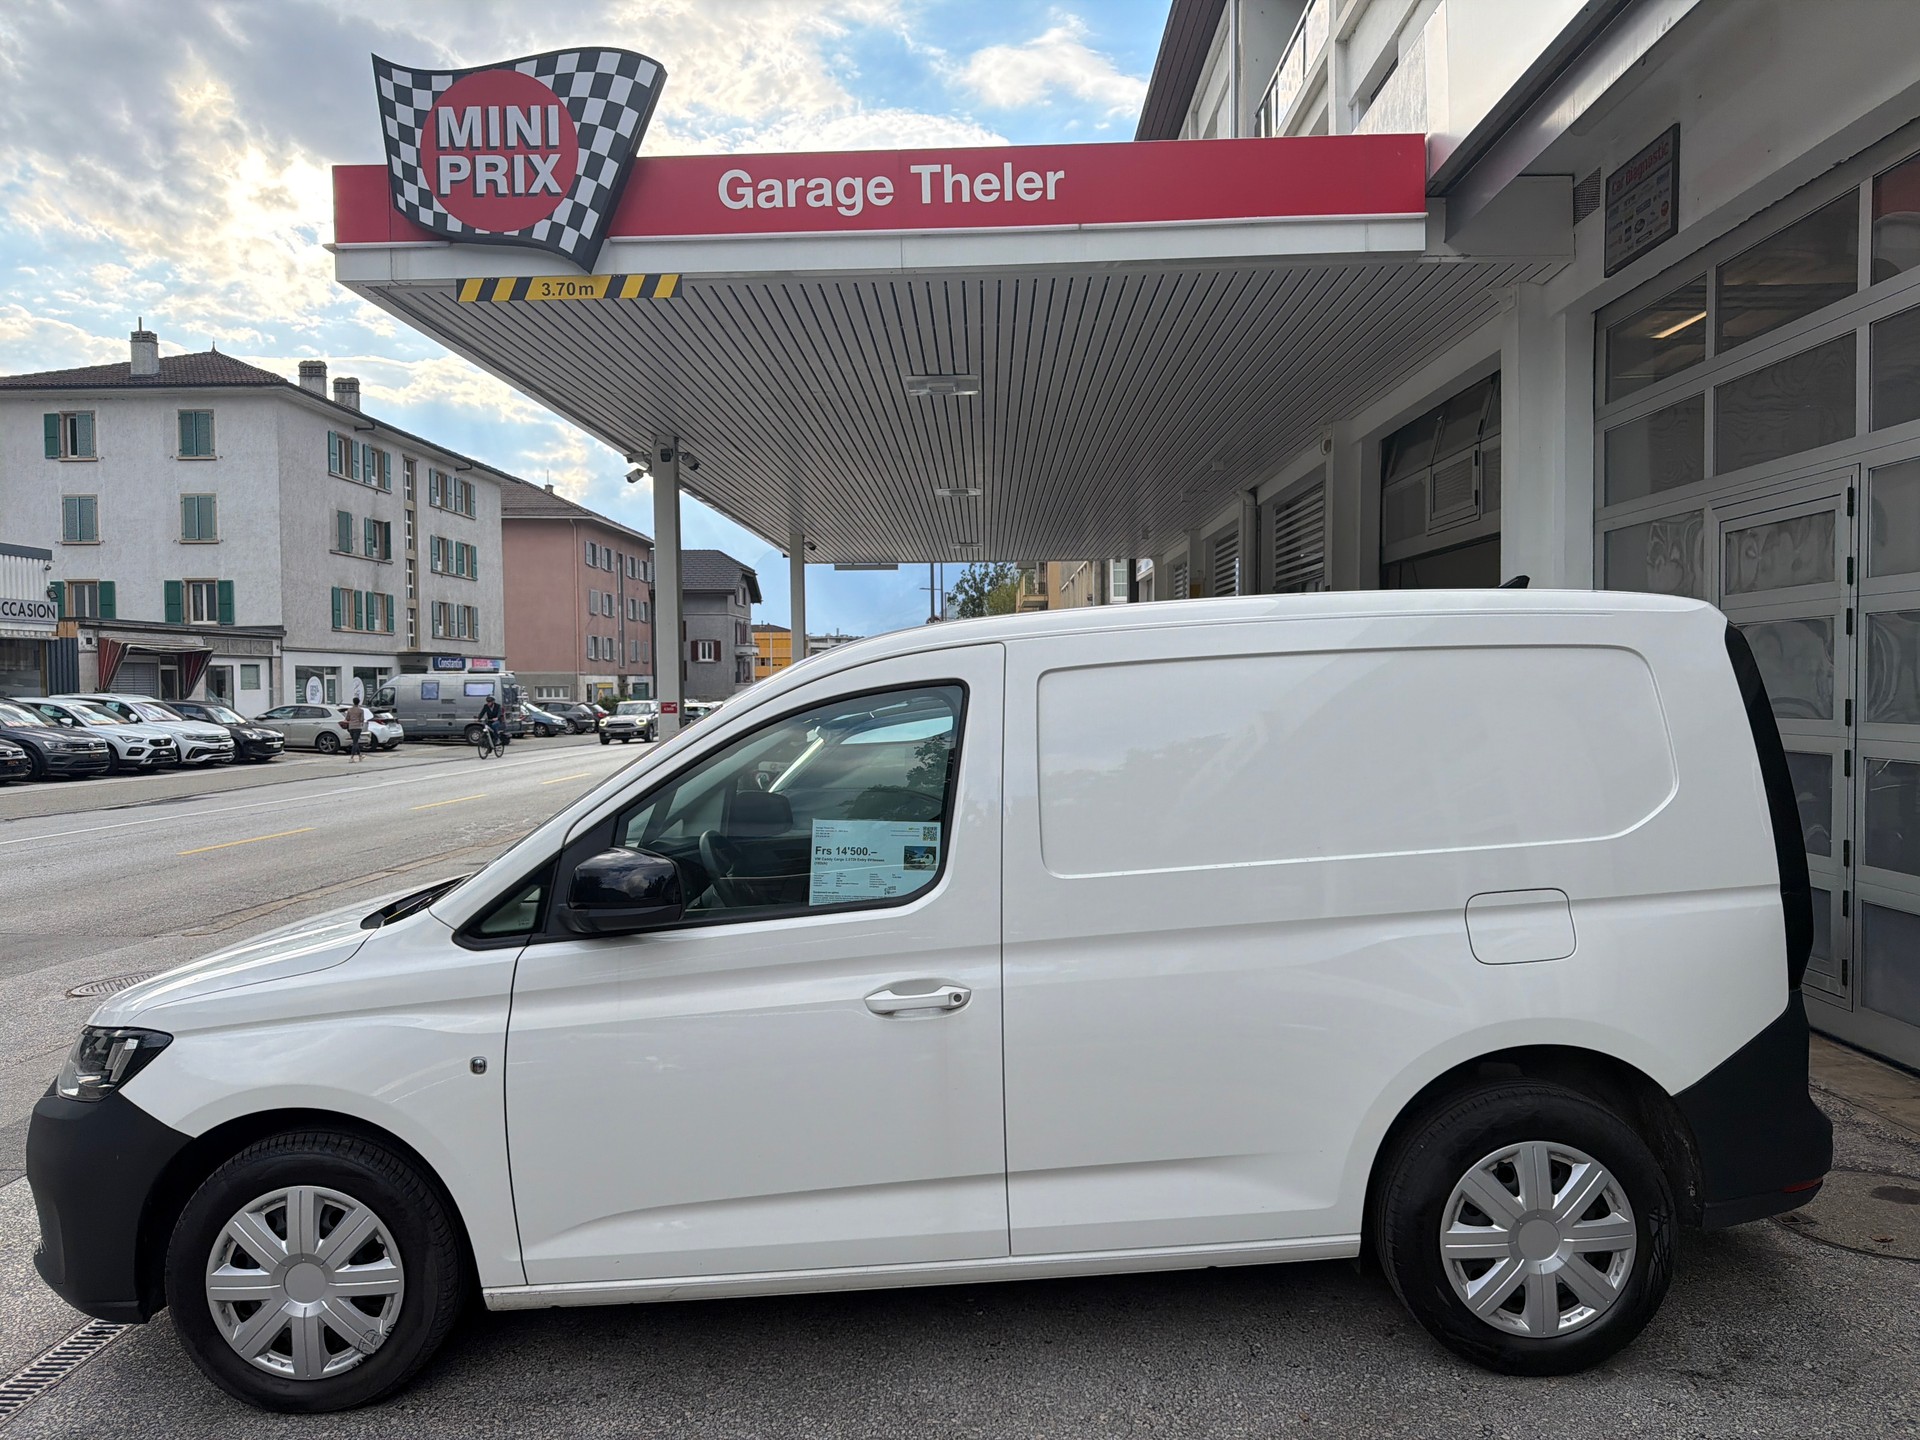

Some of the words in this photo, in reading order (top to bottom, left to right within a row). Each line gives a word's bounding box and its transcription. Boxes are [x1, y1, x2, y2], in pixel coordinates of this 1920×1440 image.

[436, 104, 560, 149] MINI
[437, 153, 562, 196] PRIX
[718, 169, 894, 216] Garage
[910, 162, 1065, 204] Theler
[541, 282, 576, 296] 3.70
[578, 285, 594, 296] m
[0, 601, 56, 619] CCASION
[437, 657, 463, 668] Constantin
[815, 846, 832, 856] Frs
